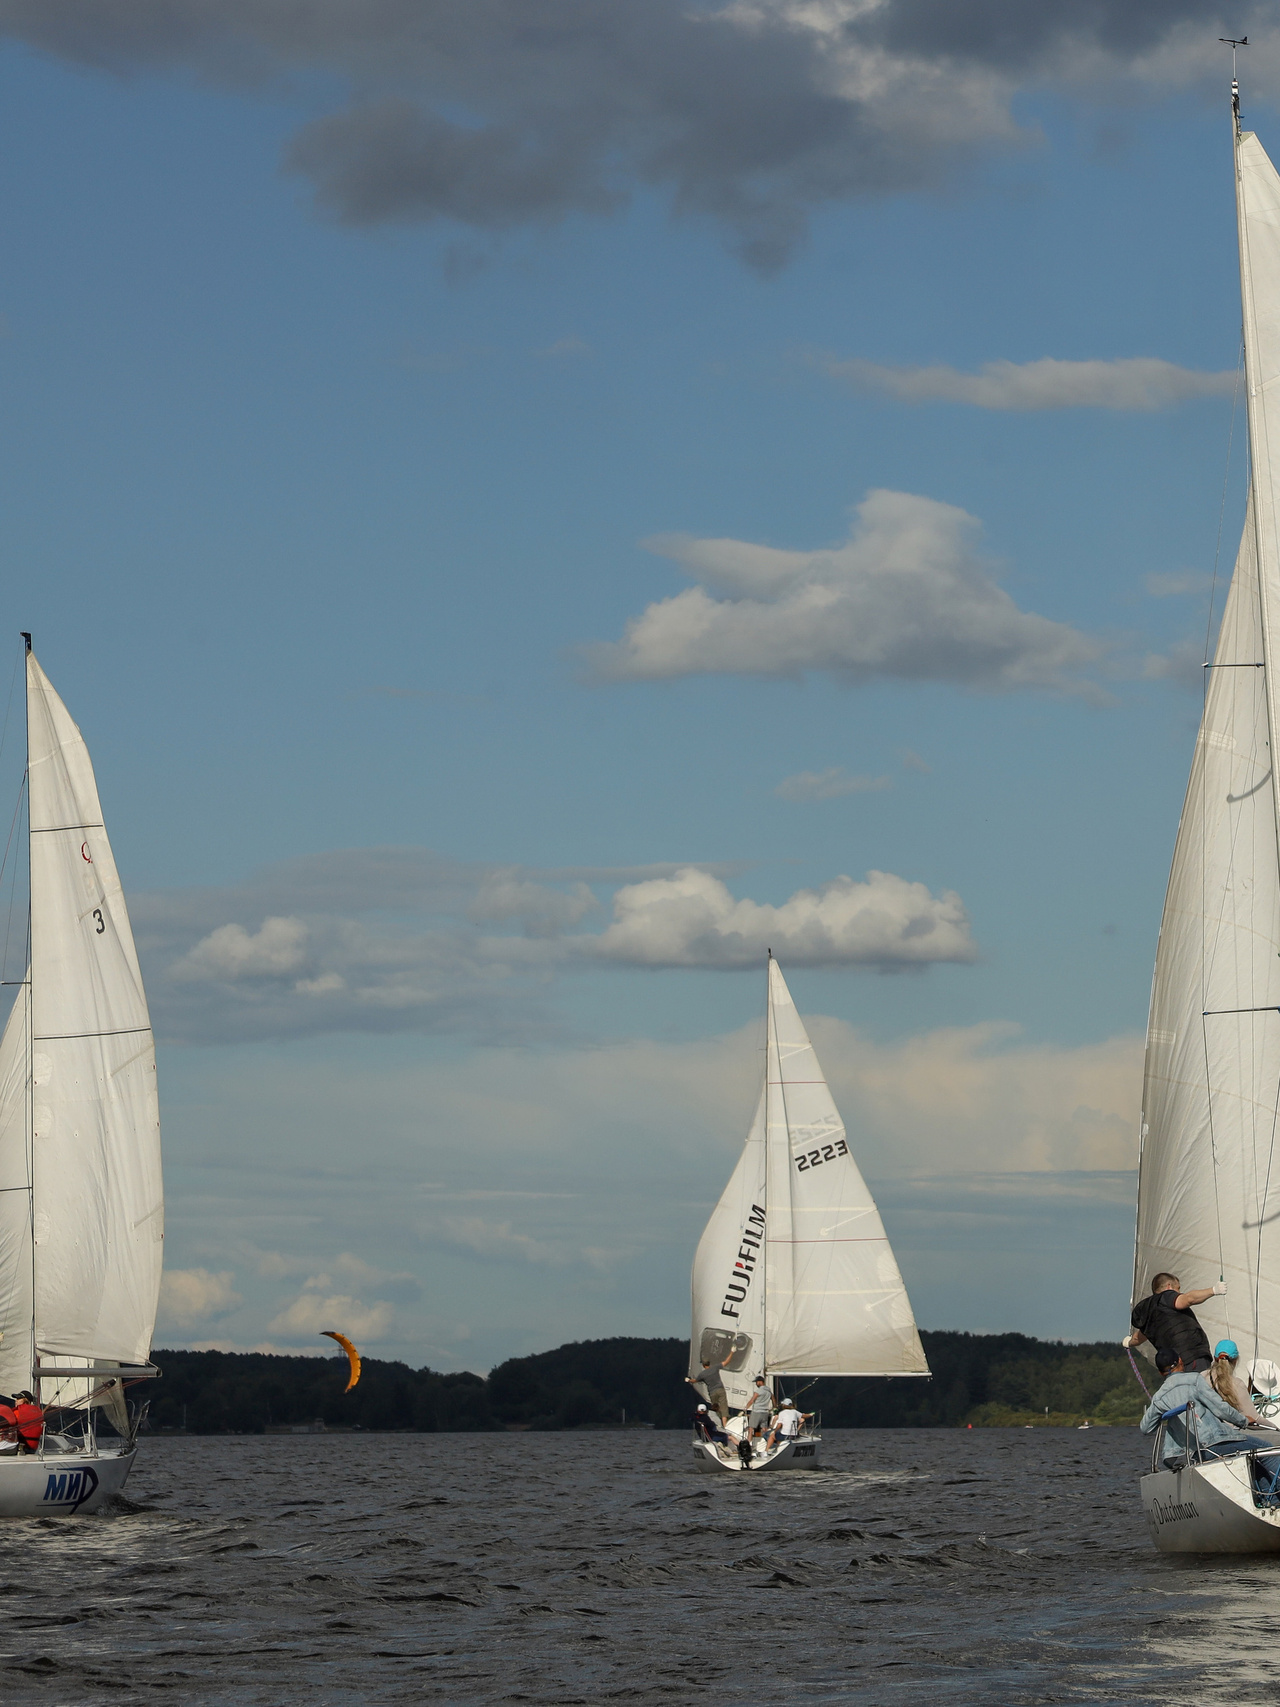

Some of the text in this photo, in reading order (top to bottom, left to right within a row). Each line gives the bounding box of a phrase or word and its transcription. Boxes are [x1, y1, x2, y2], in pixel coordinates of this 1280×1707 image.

[92, 908, 106, 935] 3
[794, 1139, 849, 1173] 2223
[721, 1204, 766, 1318] FUJIFILM
[1153, 1495, 1199, 1524] Dutchman
